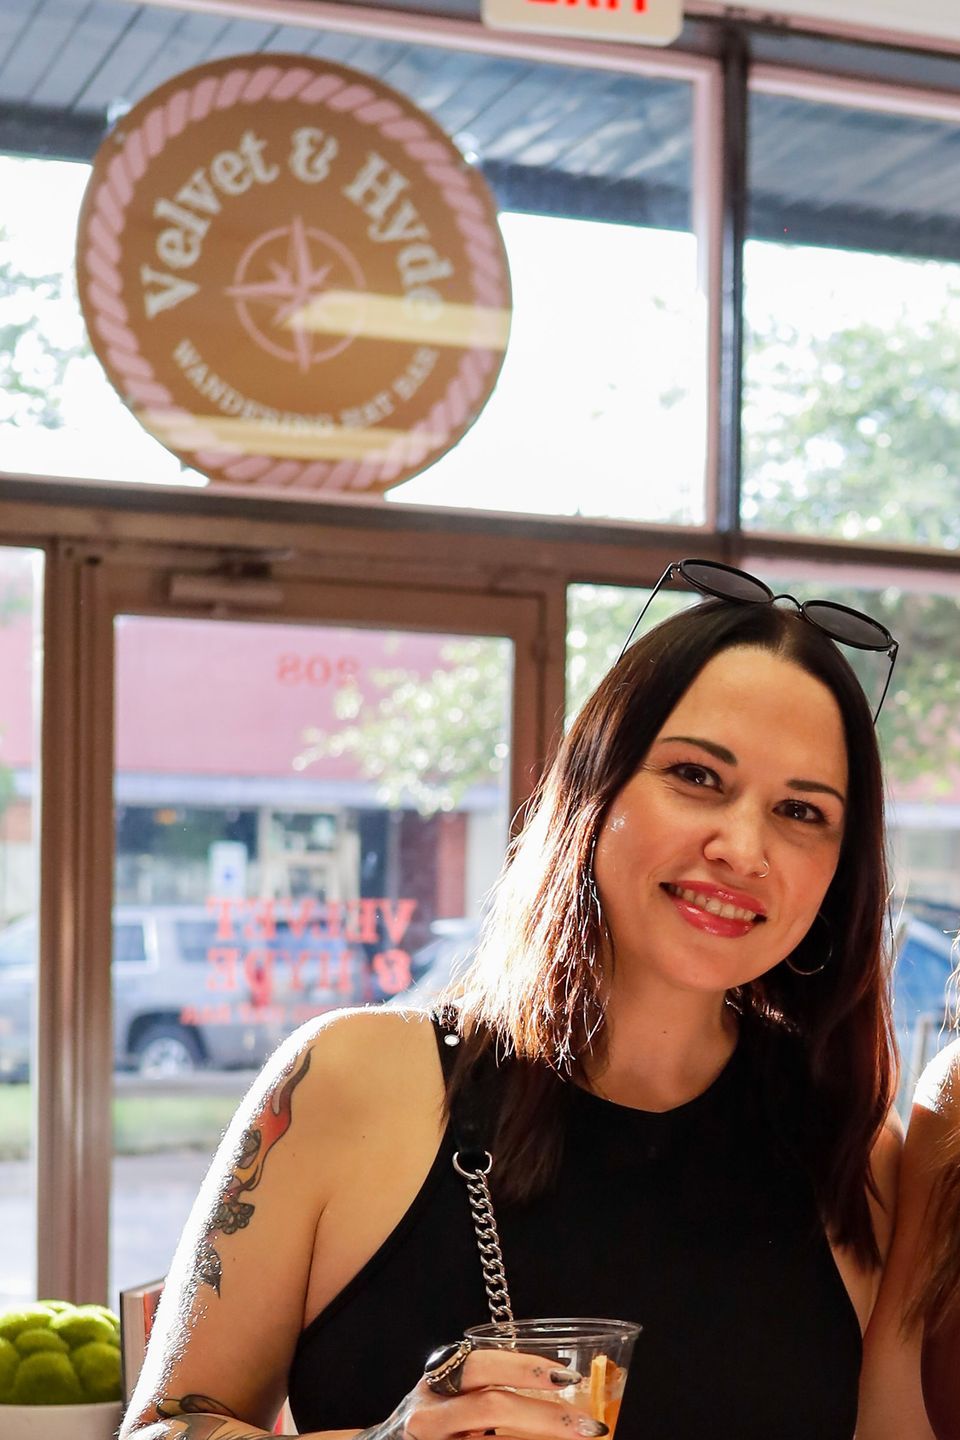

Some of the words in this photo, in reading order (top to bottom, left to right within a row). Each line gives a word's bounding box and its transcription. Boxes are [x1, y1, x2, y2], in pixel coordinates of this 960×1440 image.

[140, 129, 280, 319] Velvet
[288, 126, 340, 184] &
[342, 151, 454, 322] Hyde
